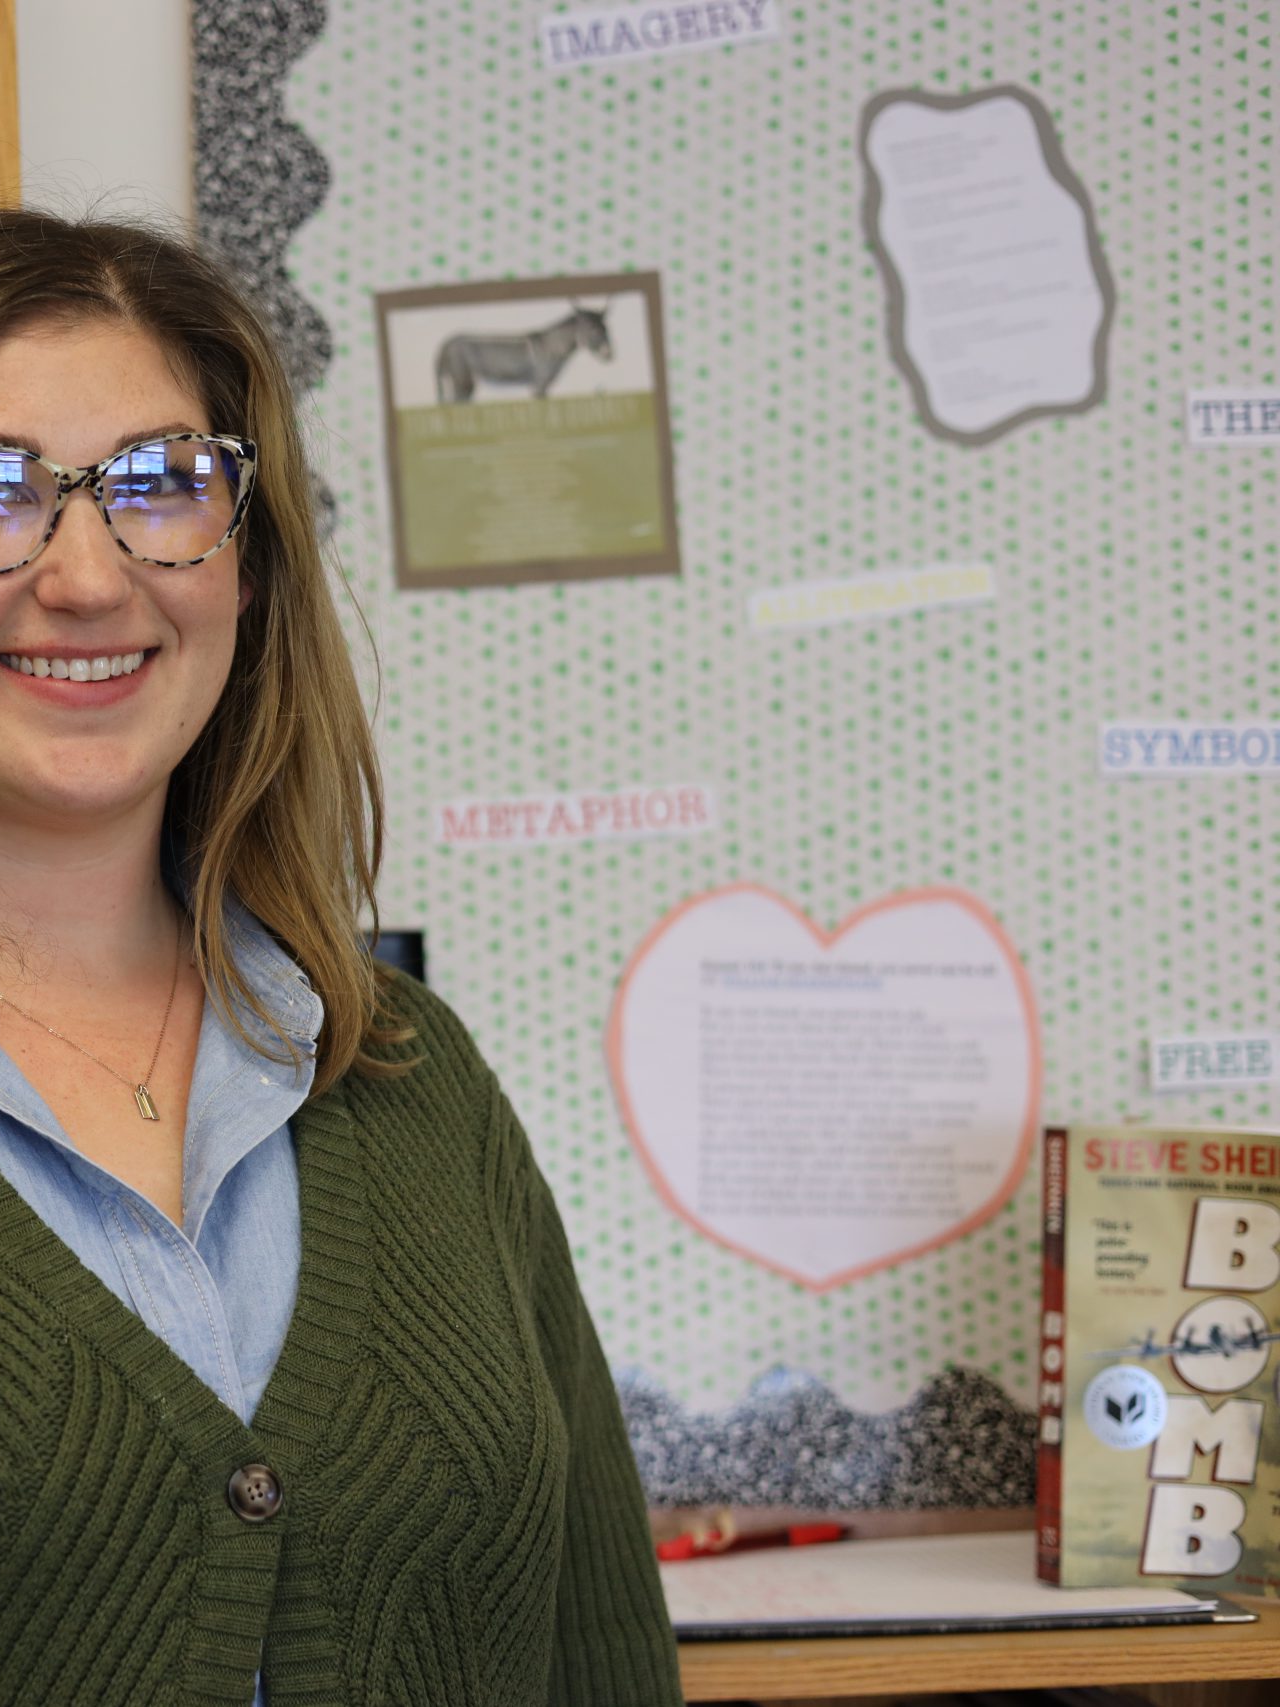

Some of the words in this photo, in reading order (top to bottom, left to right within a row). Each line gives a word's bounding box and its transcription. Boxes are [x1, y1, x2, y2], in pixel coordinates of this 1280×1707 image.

[548, 0, 767, 62] IMAGERY
[442, 788, 710, 843] METAPHOR
[1159, 1040, 1274, 1082] FREE
[1045, 1136, 1064, 1235] SHEINKIN
[1084, 1137, 1188, 1172] STEVE
[1200, 1142, 1280, 1178] SHEI
[1040, 1310, 1064, 1445] BOMB
